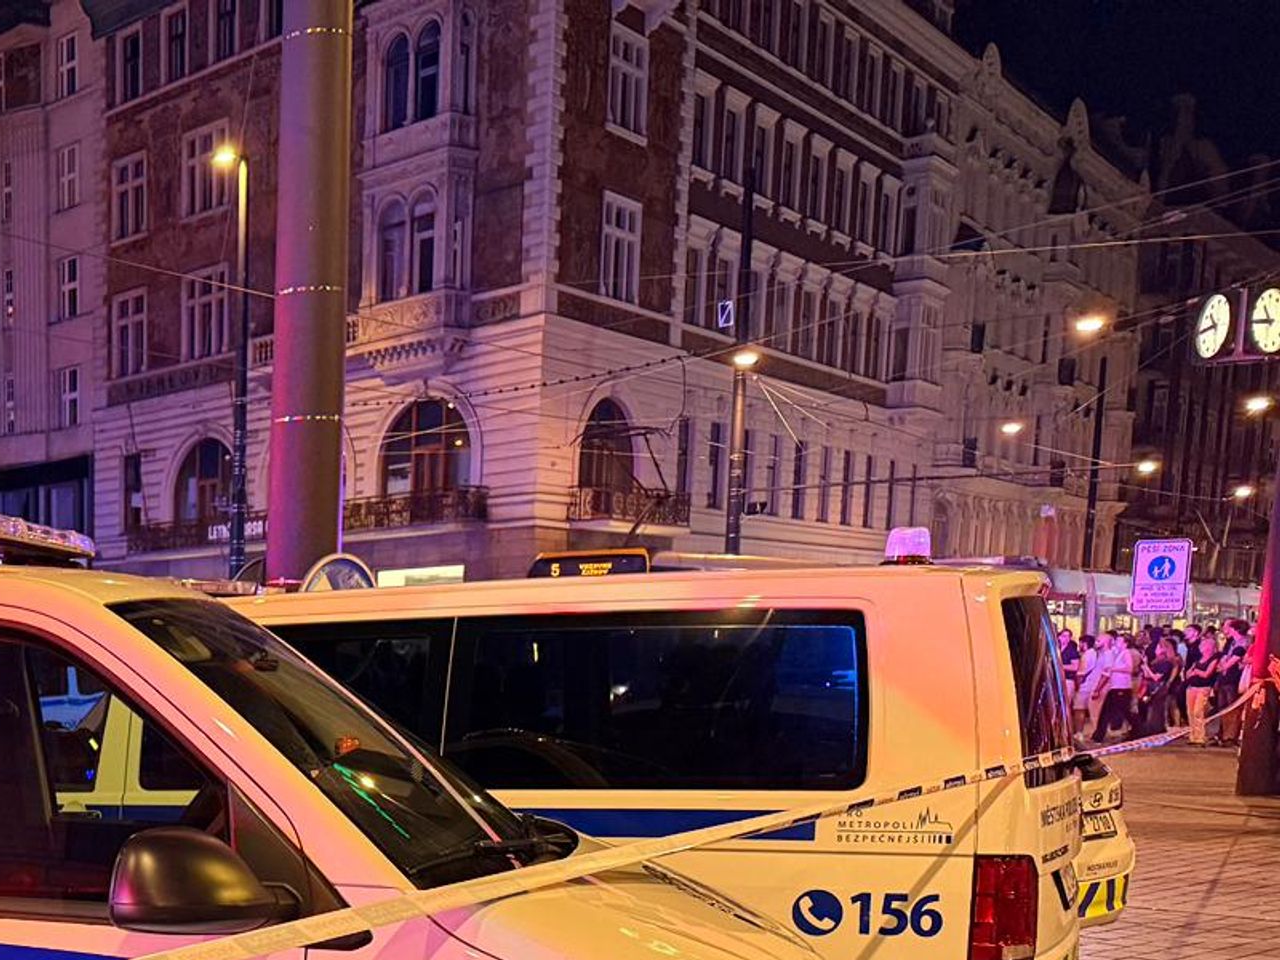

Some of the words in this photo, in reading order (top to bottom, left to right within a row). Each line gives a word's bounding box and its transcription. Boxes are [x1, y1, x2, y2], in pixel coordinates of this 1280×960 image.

[550, 563, 560, 577] 5
[838, 820, 914, 829] METROPOLI
[851, 892, 943, 937] 156
